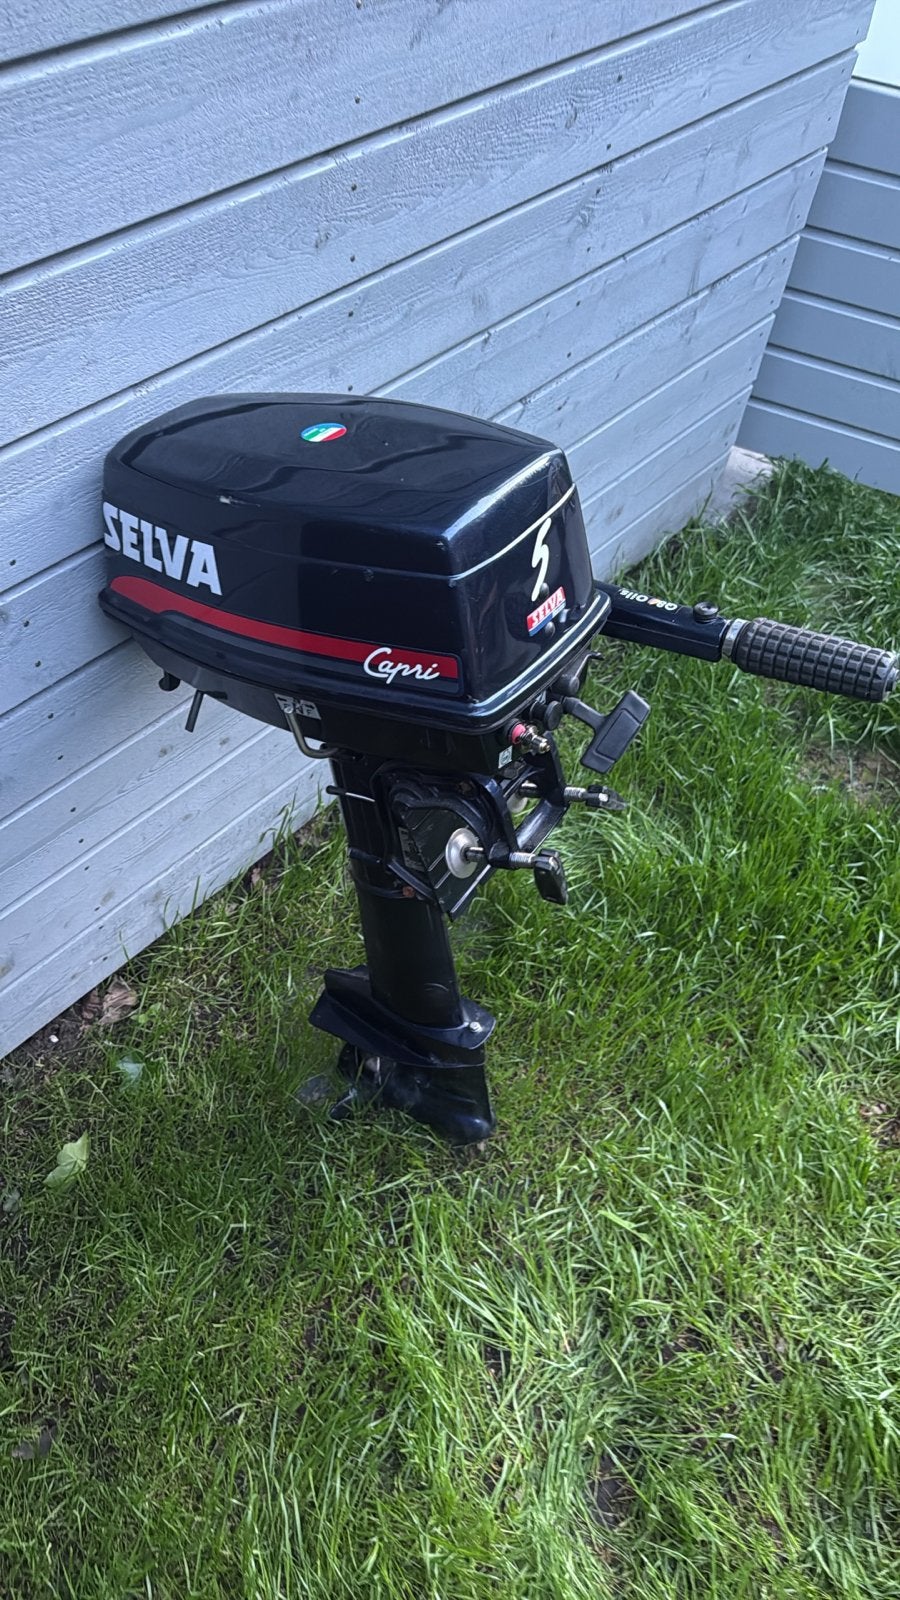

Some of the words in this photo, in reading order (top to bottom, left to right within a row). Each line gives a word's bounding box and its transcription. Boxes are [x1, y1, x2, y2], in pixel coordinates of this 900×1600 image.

[103, 501, 223, 596] SELVA
[530, 588, 565, 629] SELVA
[363, 646, 441, 685] Capri
